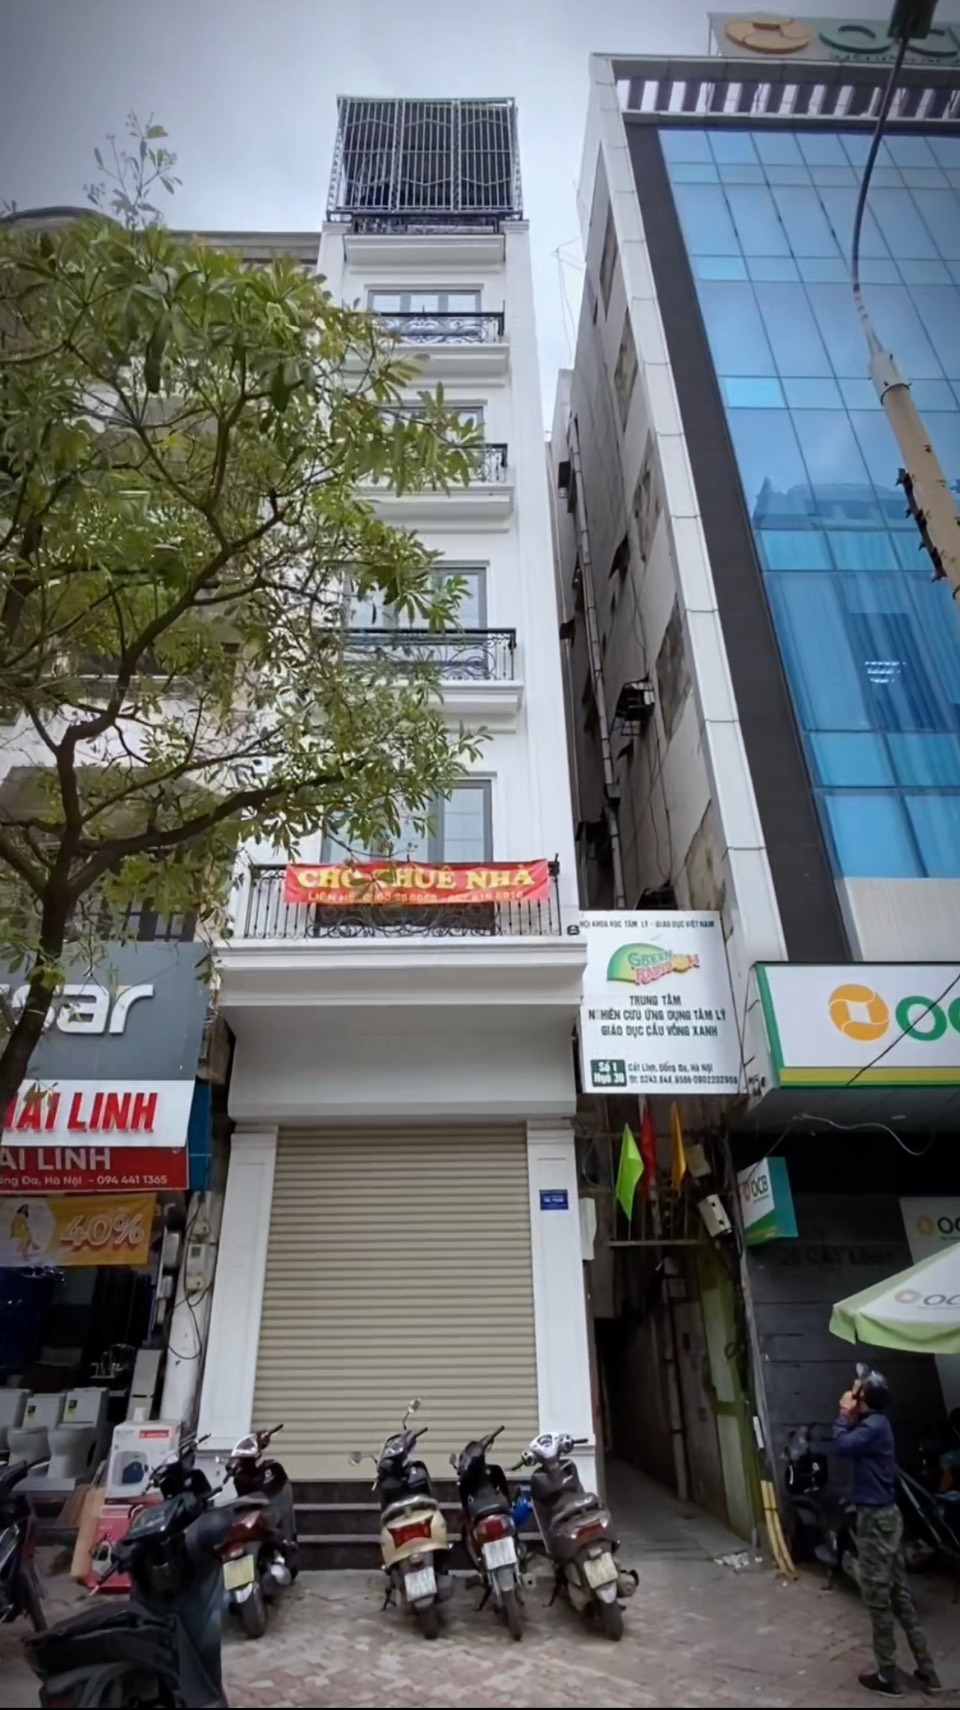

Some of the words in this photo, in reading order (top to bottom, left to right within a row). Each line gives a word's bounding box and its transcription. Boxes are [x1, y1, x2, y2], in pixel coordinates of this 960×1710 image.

[373, 864, 455, 889] HUÊ
[465, 864, 535, 888] NHÀ
[700, 920, 714, 928] NAM
[627, 950, 673, 967] GREEN
[629, 995, 658, 1006] TRUNG
[661, 993, 682, 1006] TÂM
[588, 1008, 621, 1020] NHIÊN
[667, 1010, 691, 1023] DỤNG
[694, 1007, 714, 1020] TÂM
[626, 1026, 644, 1038] DỤC
[693, 1026, 718, 1037] XANH
[612, 1062, 617, 1072] 1
[67, 1092, 158, 1131] LINH
[38, 1148, 111, 1170] LINH
[22, 1176, 41, 1185] Đa,
[45, 1176, 60, 1184] Hà
[64, 1176, 82, 1187] Nội
[97, 1175, 118, 1184] 094
[121, 1175, 140, 1184] 441
[144, 1175, 168, 1184] 1365
[751, 1174, 769, 1198] OCB
[61, 1215, 144, 1246] 40%
